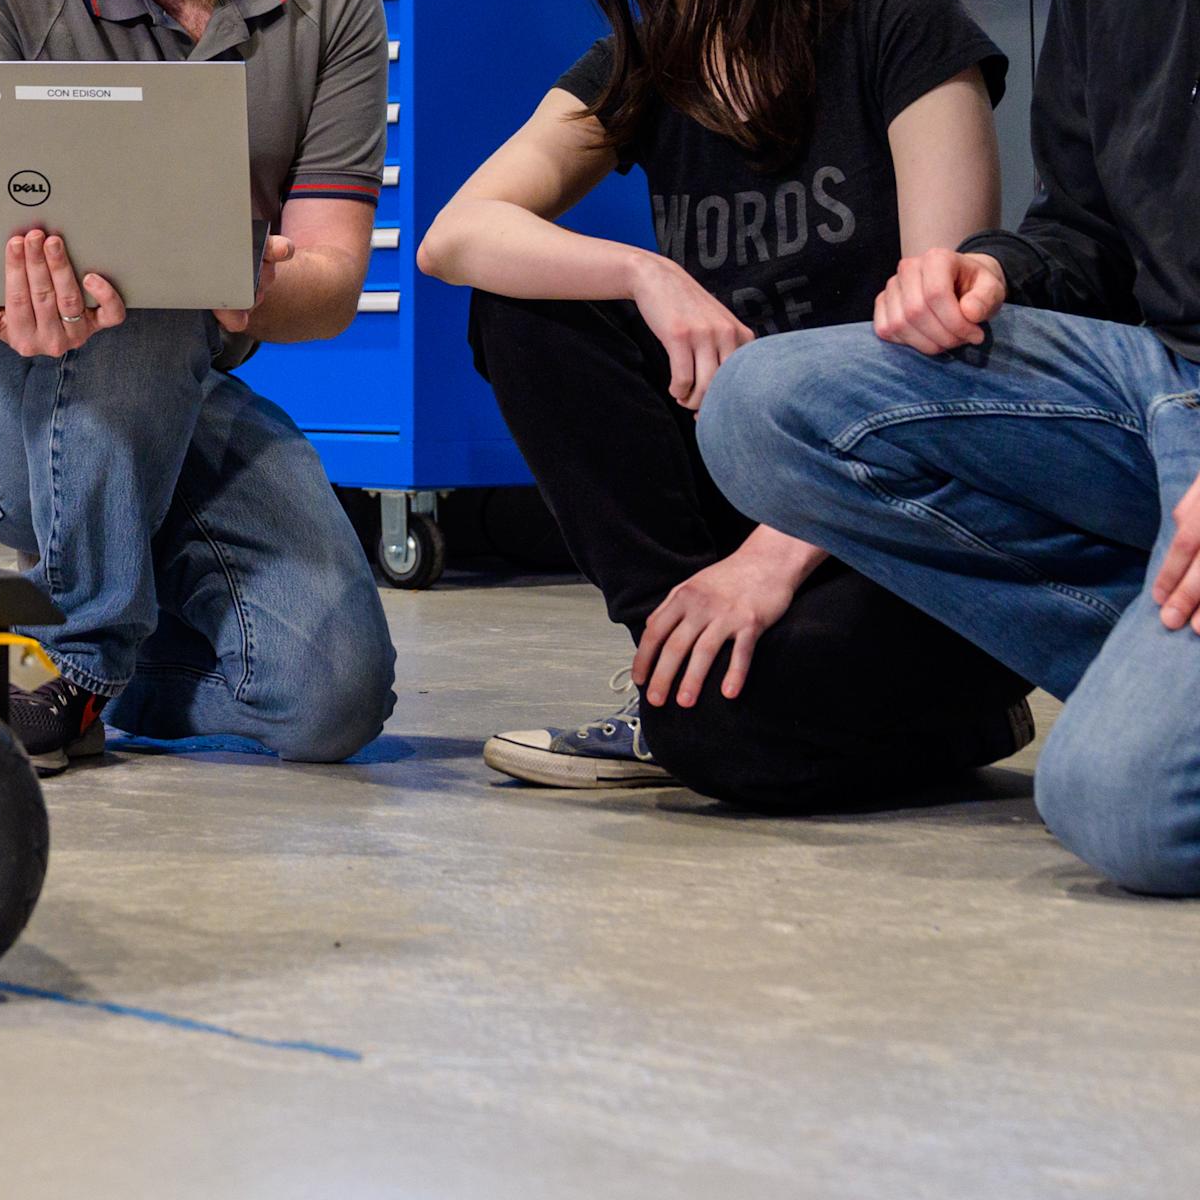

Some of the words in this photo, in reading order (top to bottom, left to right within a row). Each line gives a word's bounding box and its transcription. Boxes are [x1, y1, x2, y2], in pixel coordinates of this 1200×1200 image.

[47, 87, 70, 98] CON
[72, 88, 112, 99] EDISON
[12, 183, 47, 194] DELL
[652, 164, 856, 270] WORDS
